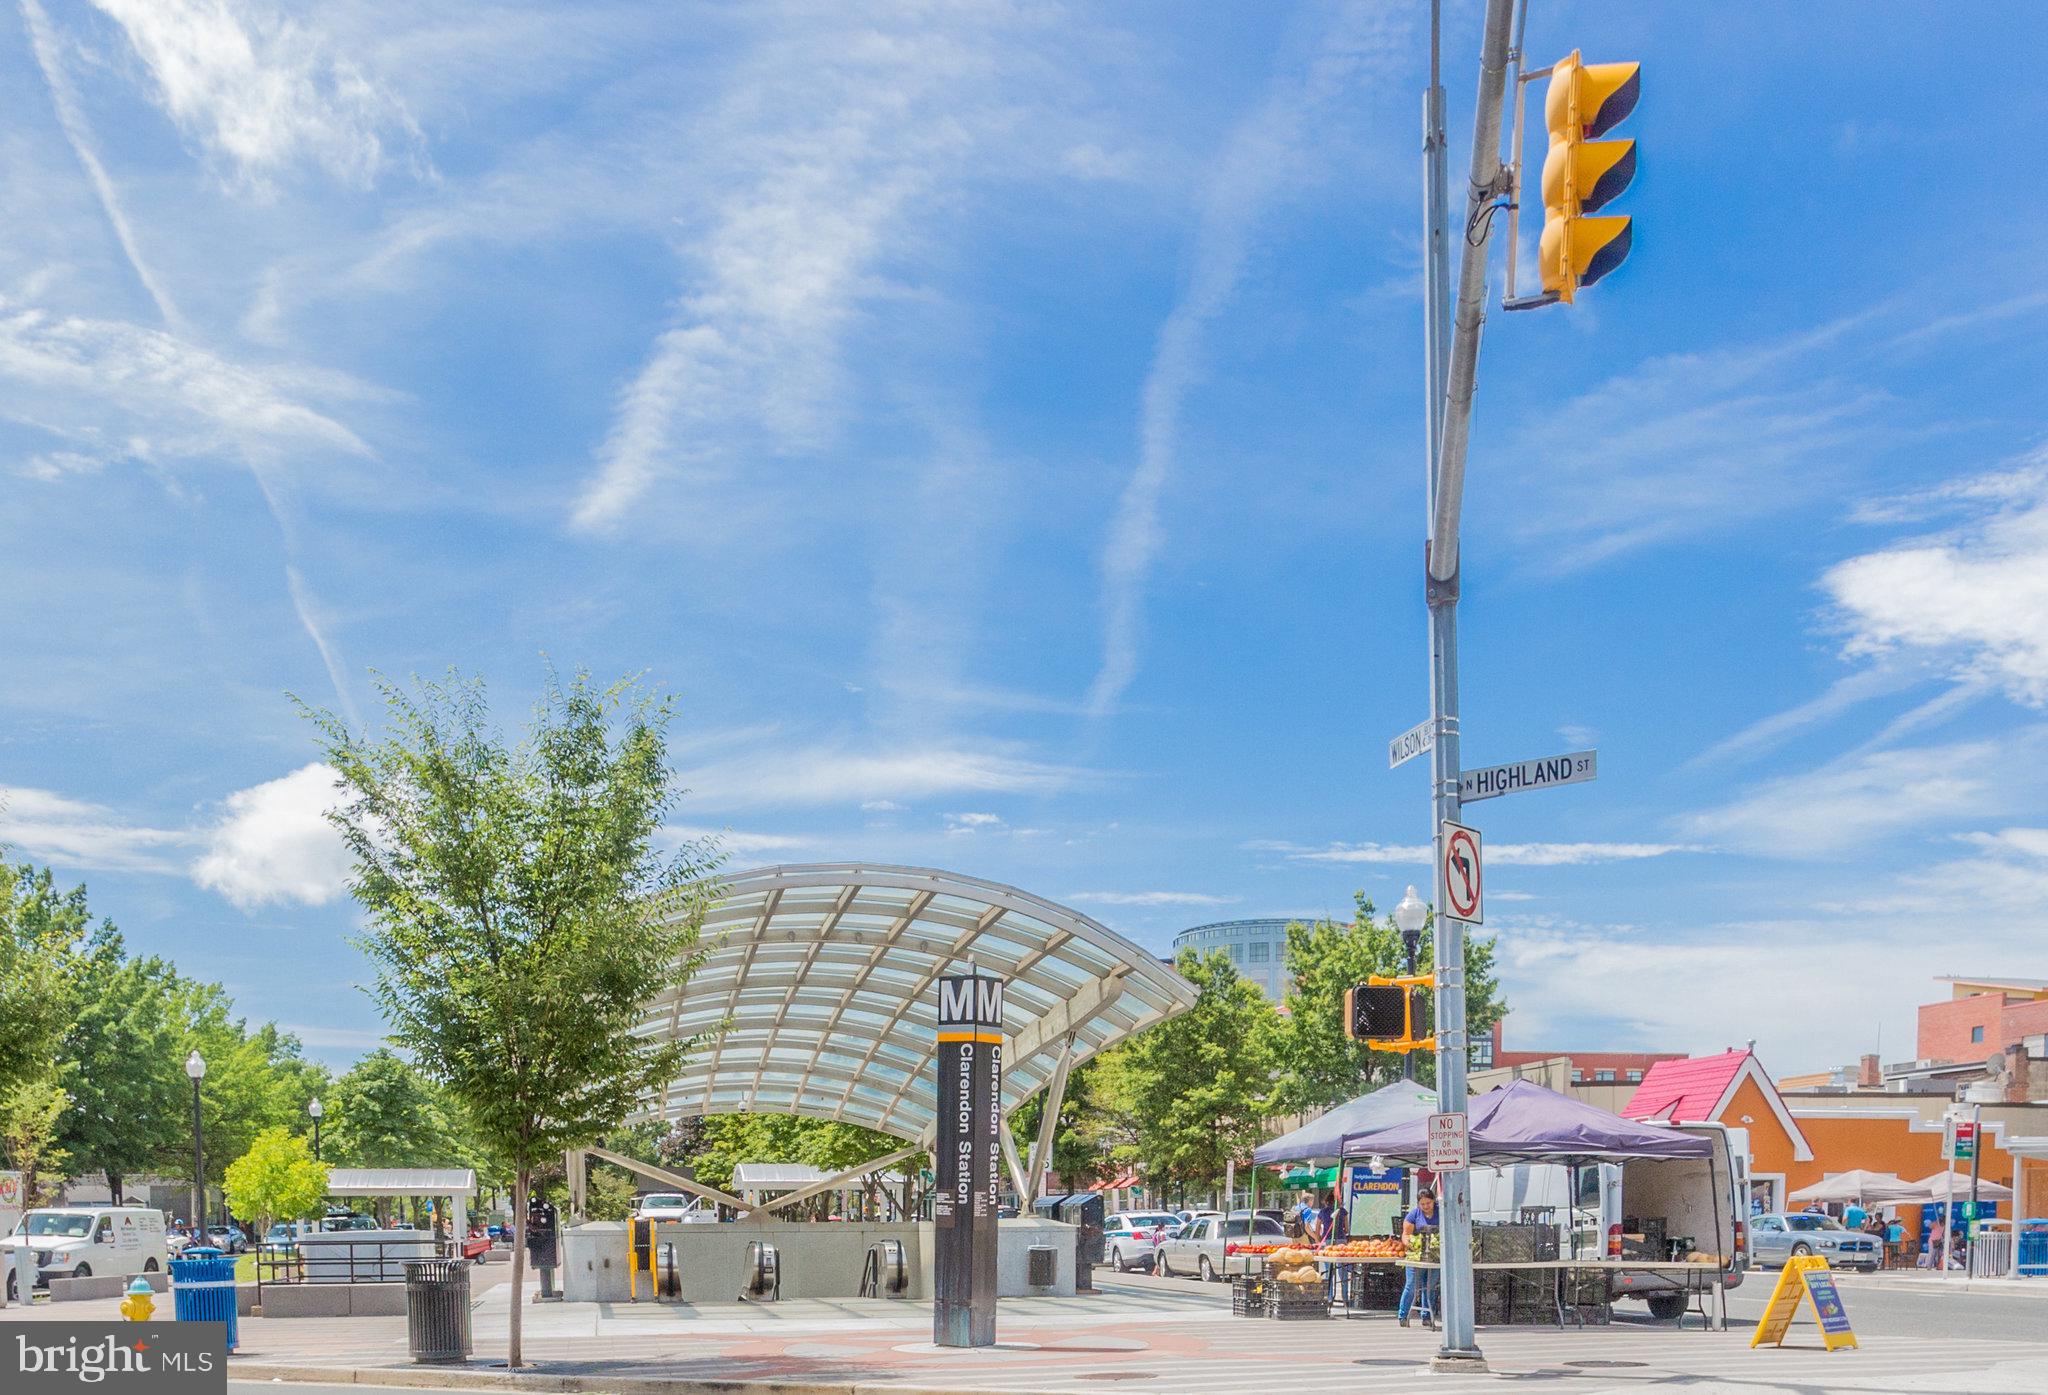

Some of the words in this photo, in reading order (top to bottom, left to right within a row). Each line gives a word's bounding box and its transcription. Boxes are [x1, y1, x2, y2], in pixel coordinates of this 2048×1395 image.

[1391, 730, 1421, 764] WILSON
[1466, 780, 1473, 790] N
[1477, 758, 1572, 793] HIGHLAND
[1577, 759, 1590, 772] ST
[941, 979, 974, 1021] M
[978, 979, 1003, 1023] M
[959, 1043, 973, 1133] Clarendon
[990, 1045, 1001, 1135] Clarendon
[1430, 1131, 1463, 1140] STOPPING
[1440, 1118, 1453, 1129] NO
[1431, 1148, 1464, 1157] STANDING
[1442, 1140, 1452, 1148] OR
[958, 1141, 972, 1204] Station
[989, 1142, 1000, 1205] Station
[1353, 1182, 1400, 1191] CLARENDON
